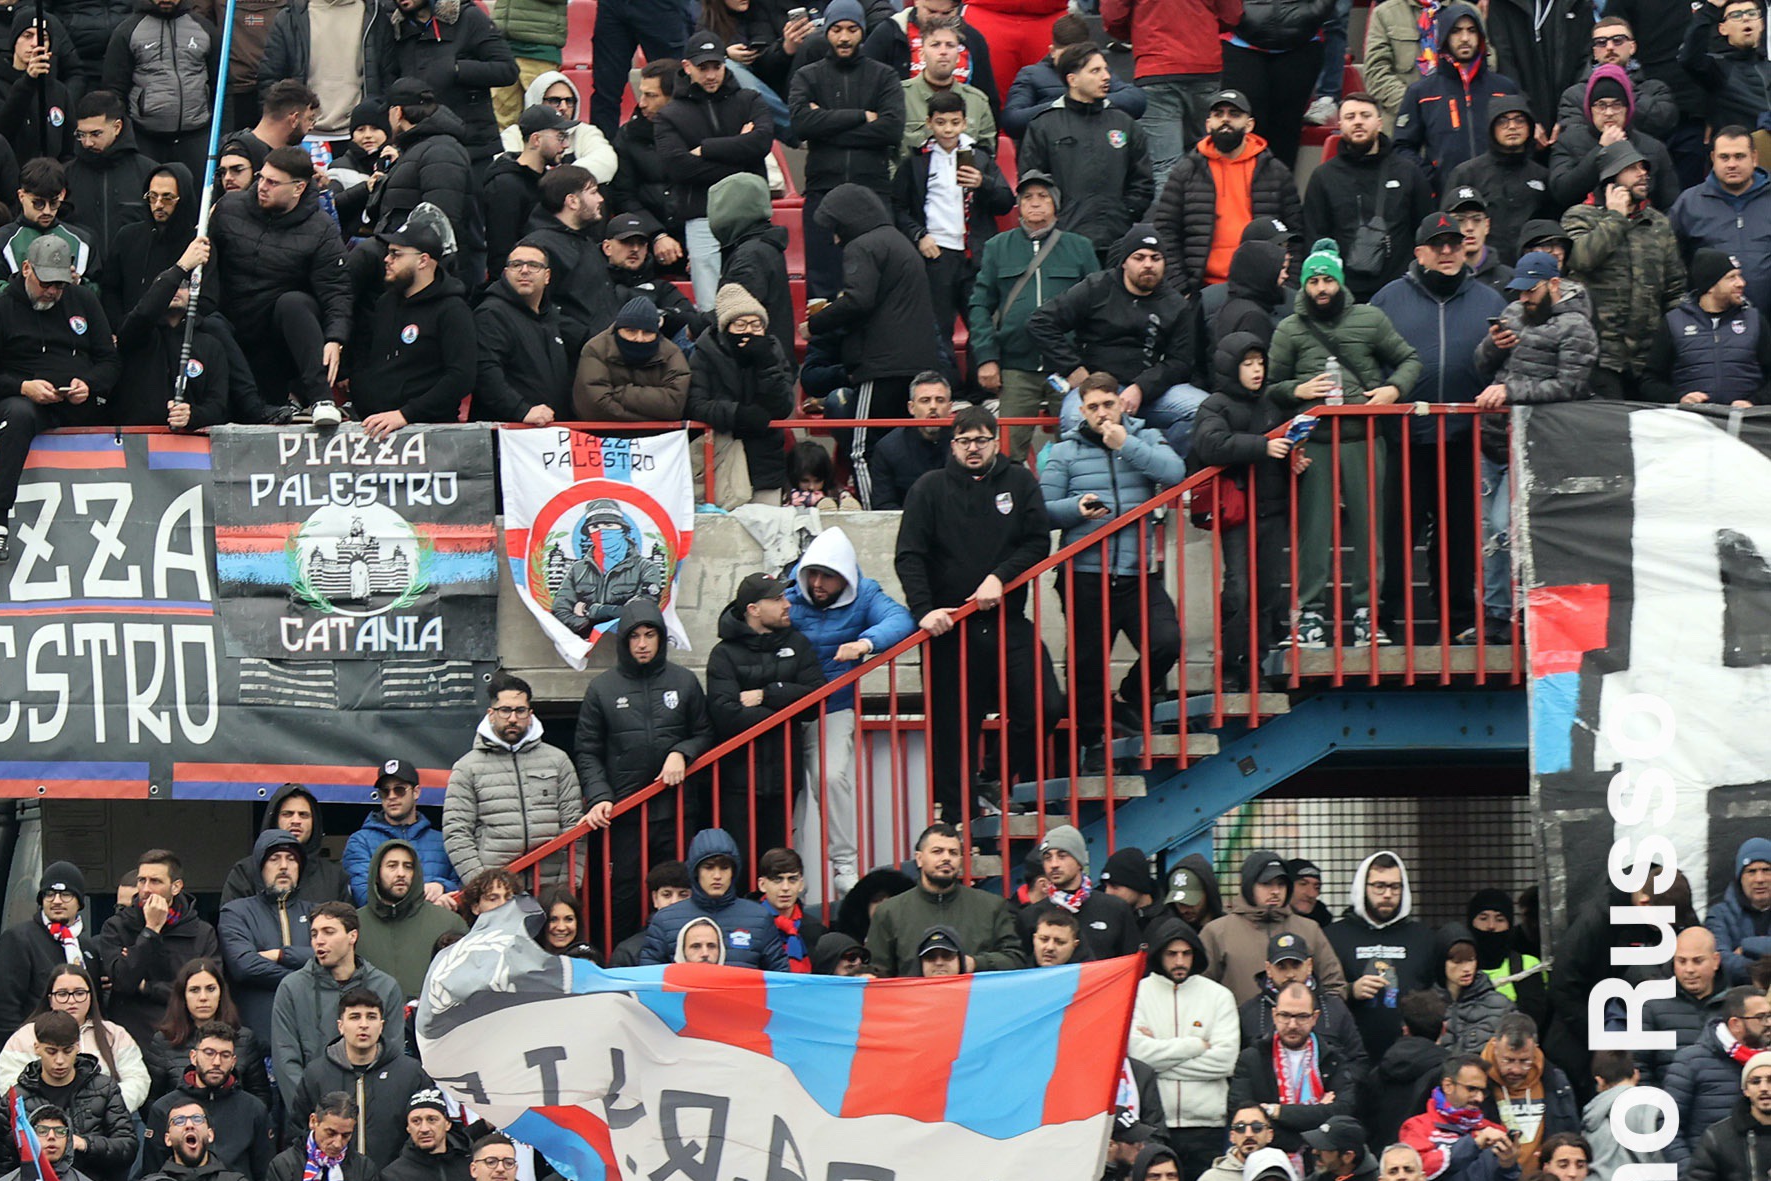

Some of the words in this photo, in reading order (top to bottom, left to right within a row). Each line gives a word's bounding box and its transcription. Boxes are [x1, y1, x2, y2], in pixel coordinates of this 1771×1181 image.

[278, 432, 427, 466] PIAZZA
[558, 430, 640, 450] PIAZZA
[542, 451, 656, 471] PALESTRO
[250, 472, 458, 507] PALESTRO
[280, 615, 444, 651] CATANIA
